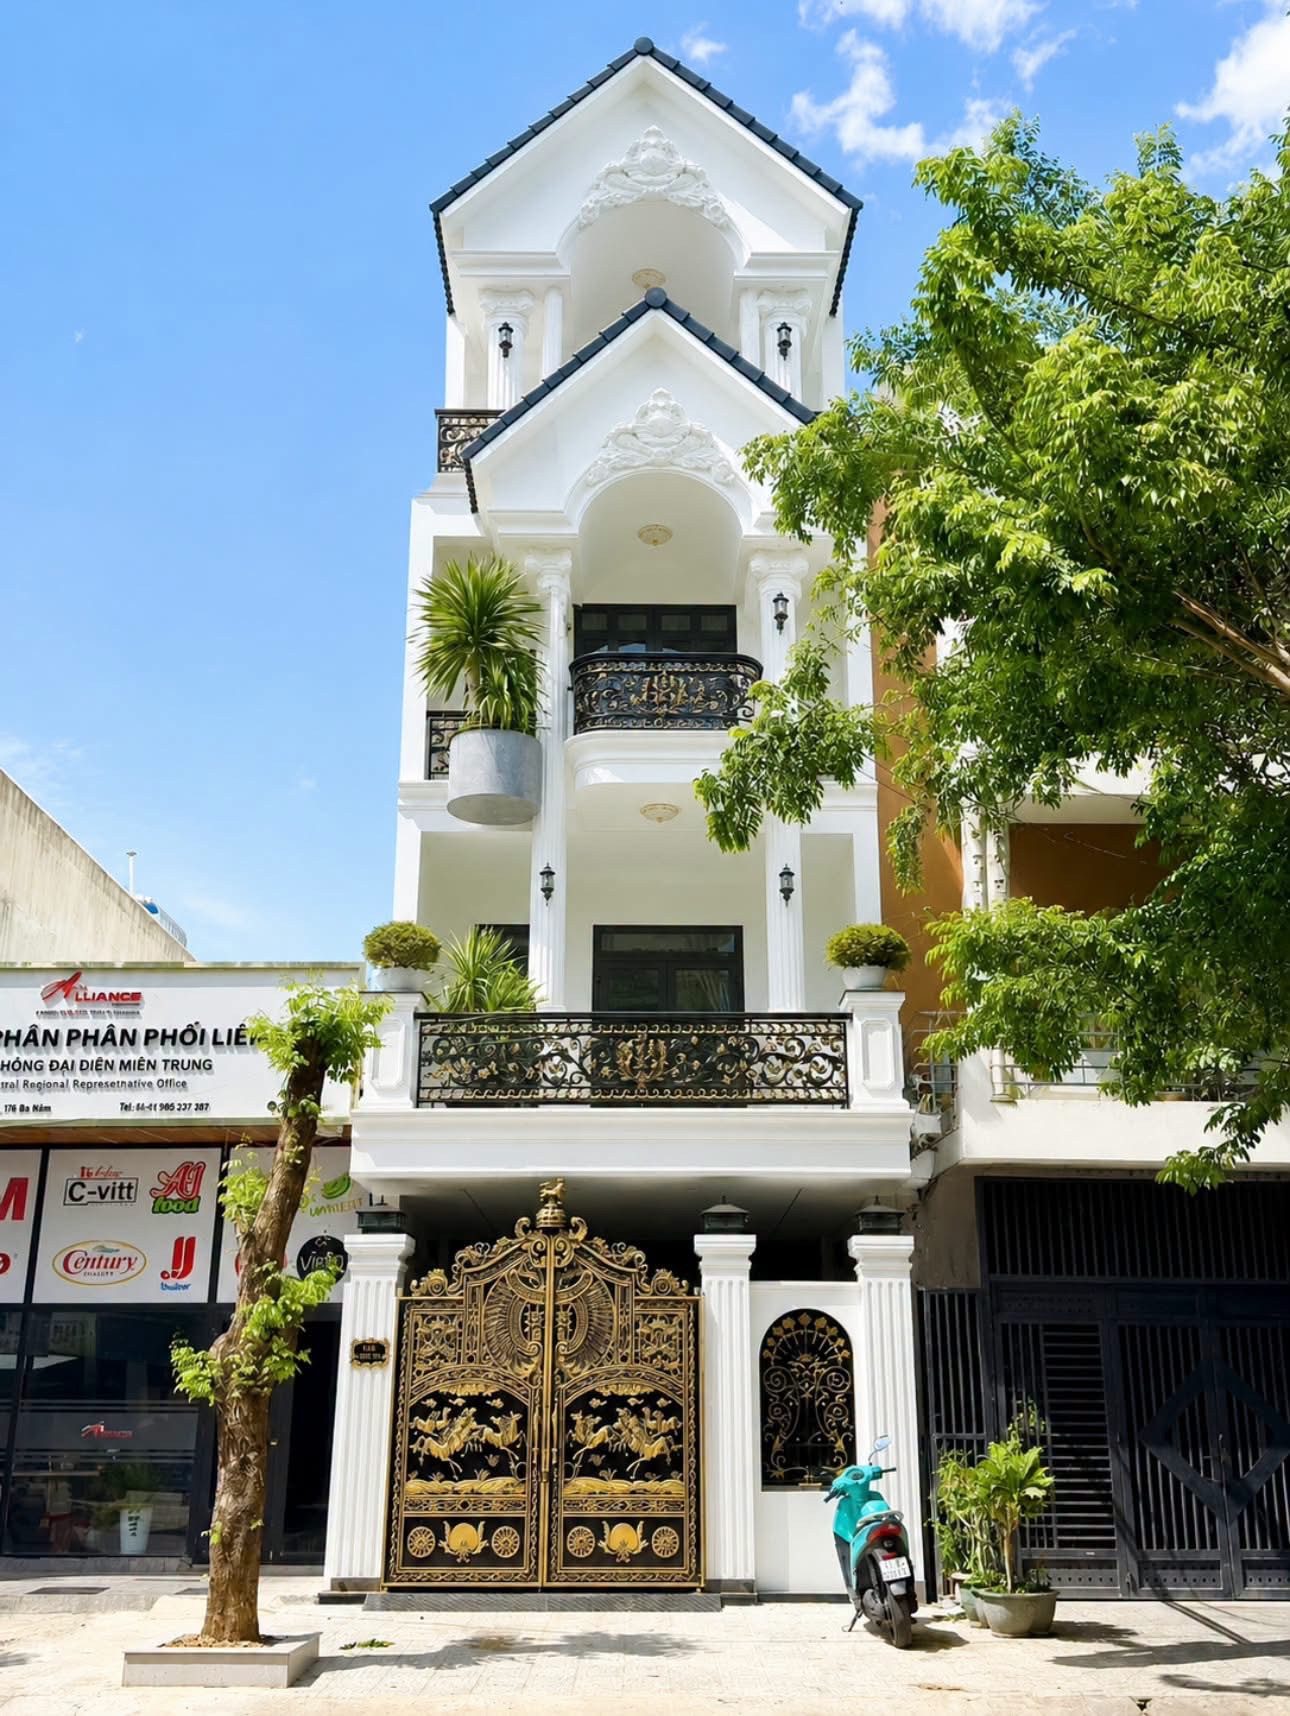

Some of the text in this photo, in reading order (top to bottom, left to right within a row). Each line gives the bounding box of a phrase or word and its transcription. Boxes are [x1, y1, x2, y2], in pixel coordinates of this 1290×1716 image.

[0, 1024, 59, 1047] HÂN
[66, 1024, 138, 1047] PHÂN
[144, 1021, 206, 1047] PHỐI
[162, 1059, 213, 1072] TRUNG
[22, 1080, 69, 1092] Regional
[156, 1079, 188, 1089] Office
[67, 1181, 135, 1203] C-vitt
[152, 1196, 200, 1214] food
[62, 1249, 138, 1275] Century
